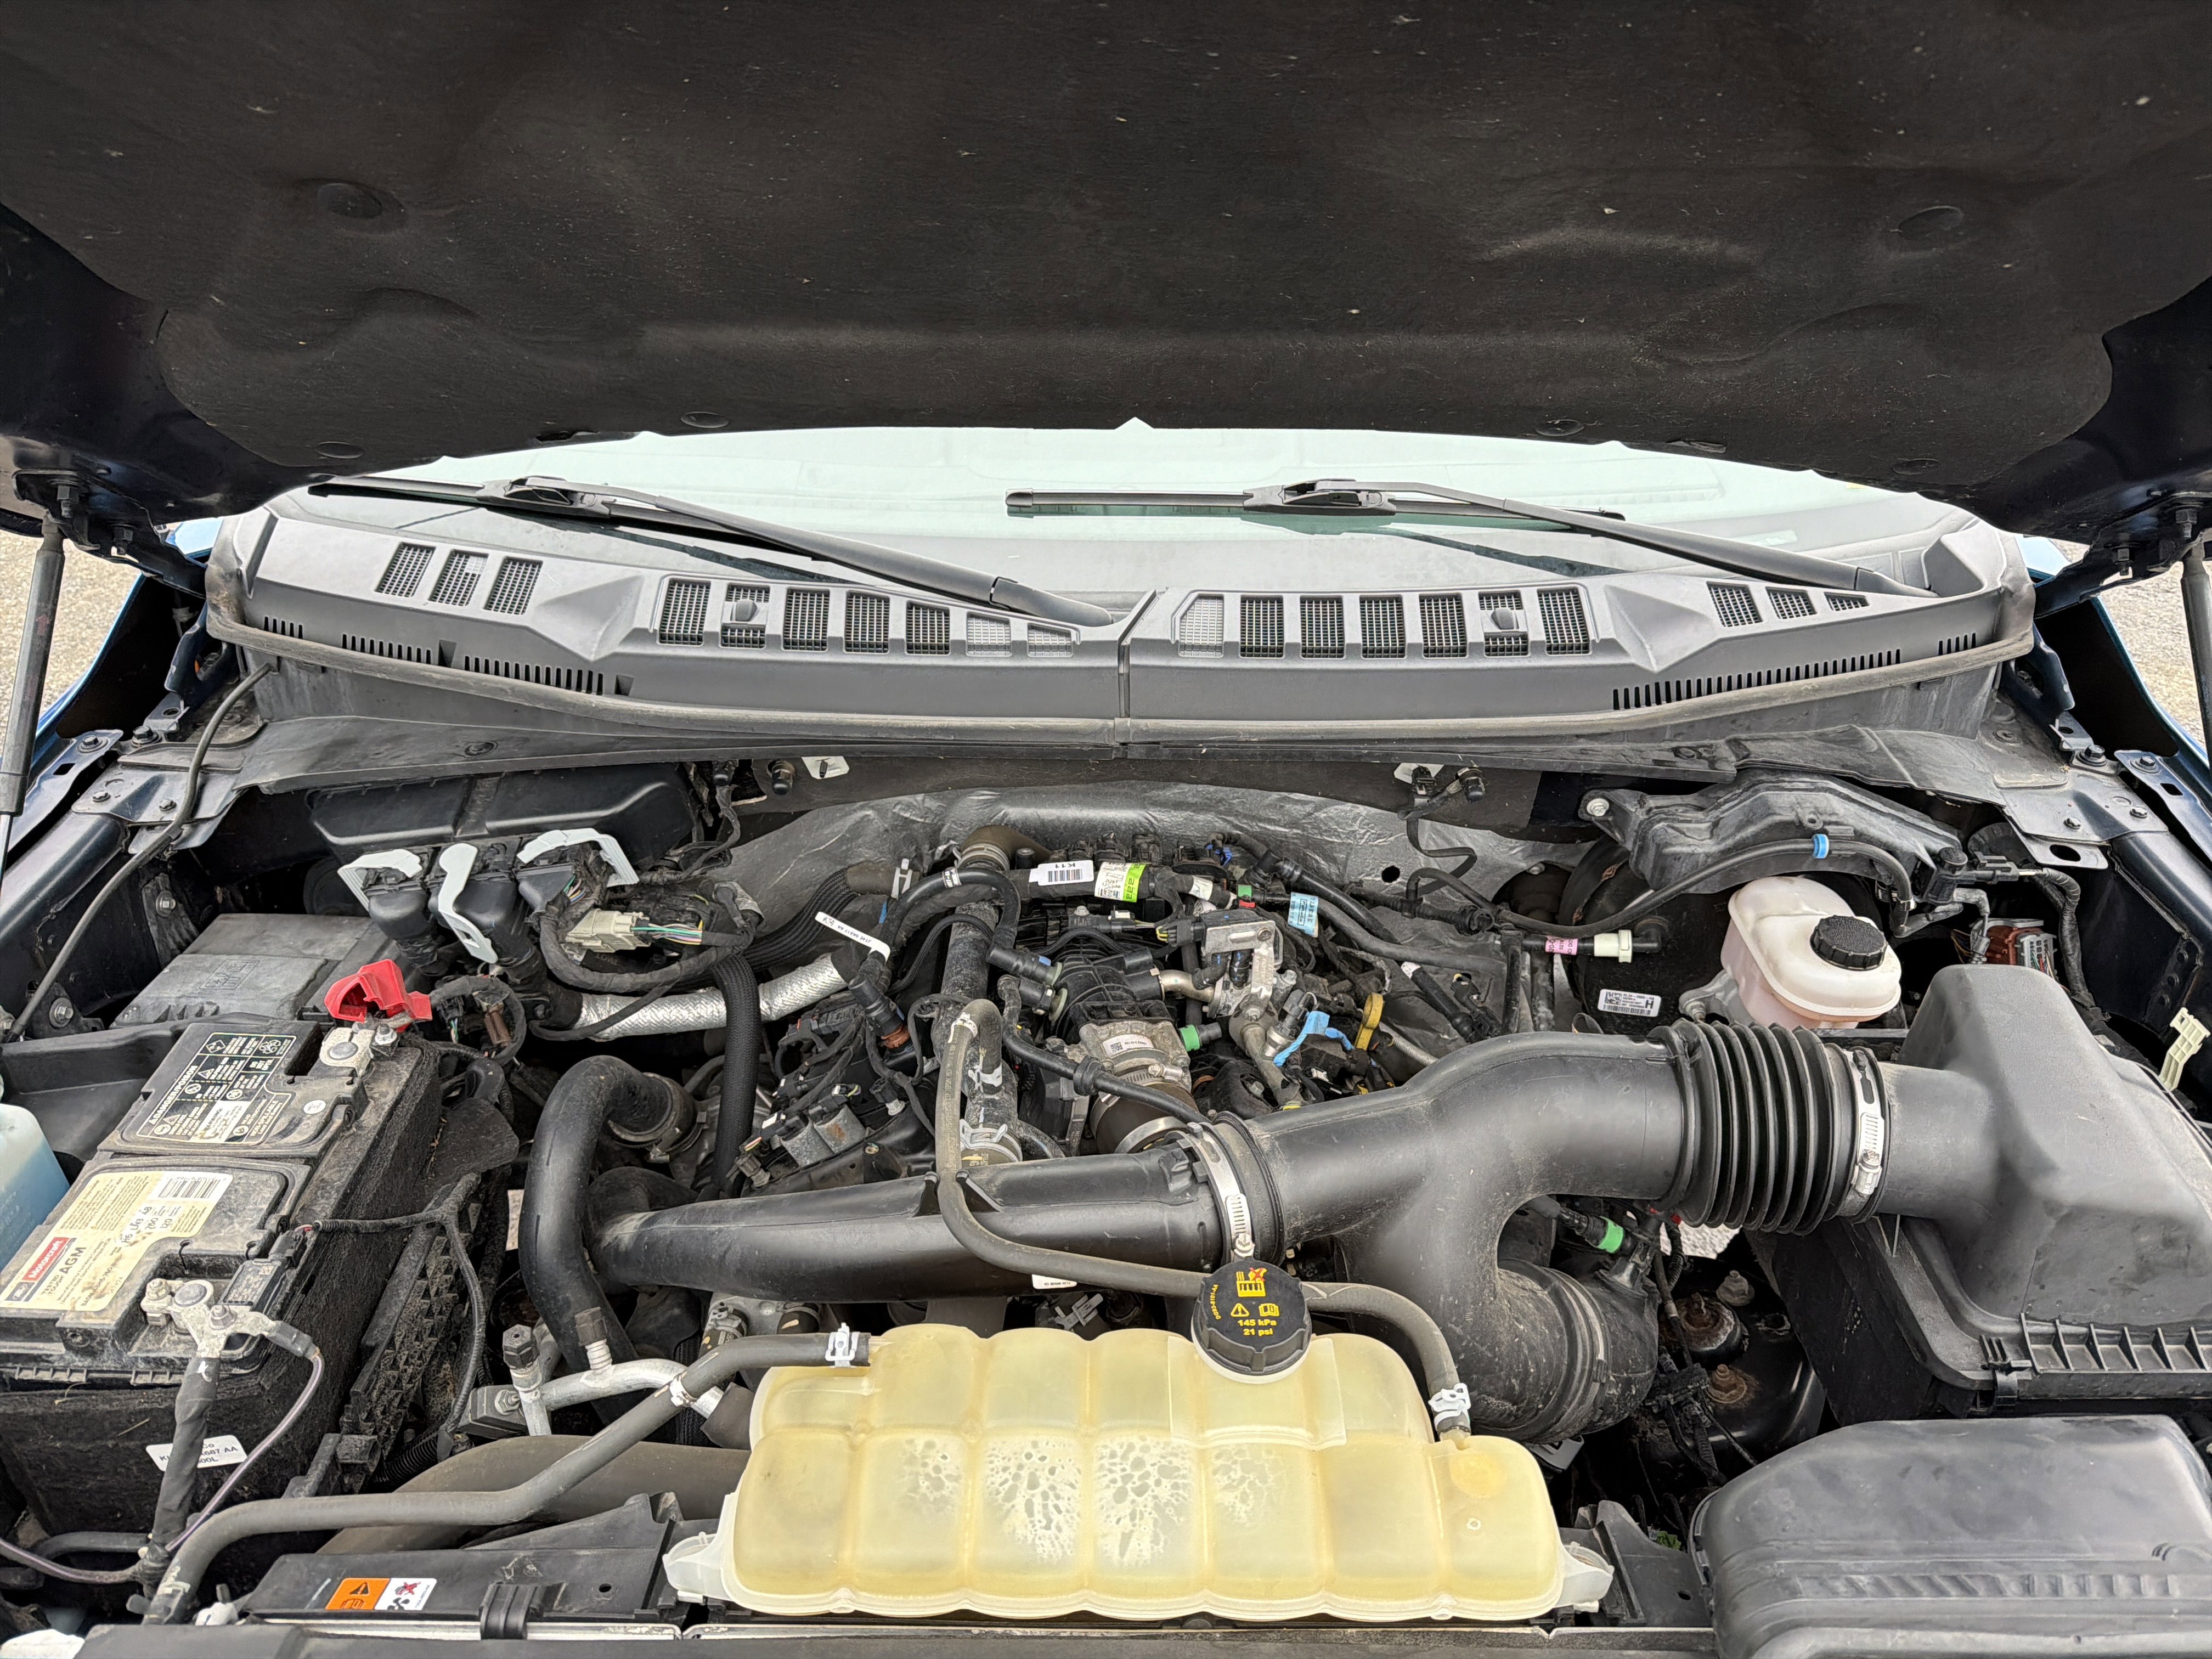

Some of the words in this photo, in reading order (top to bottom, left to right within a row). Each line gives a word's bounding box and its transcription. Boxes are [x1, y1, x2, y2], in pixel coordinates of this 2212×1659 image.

[1645, 1000, 1654, 1009] H
[154, 1065, 199, 1119] DANGER/POISON
[139, 1206, 154, 1215] 48
[159, 1218, 174, 1228] 120
[27, 1239, 65, 1278] Motorcraft
[60, 1247, 87, 1274] AGM
[41, 1274, 60, 1295] TESTED
[1258, 1328, 1273, 1337] psi
